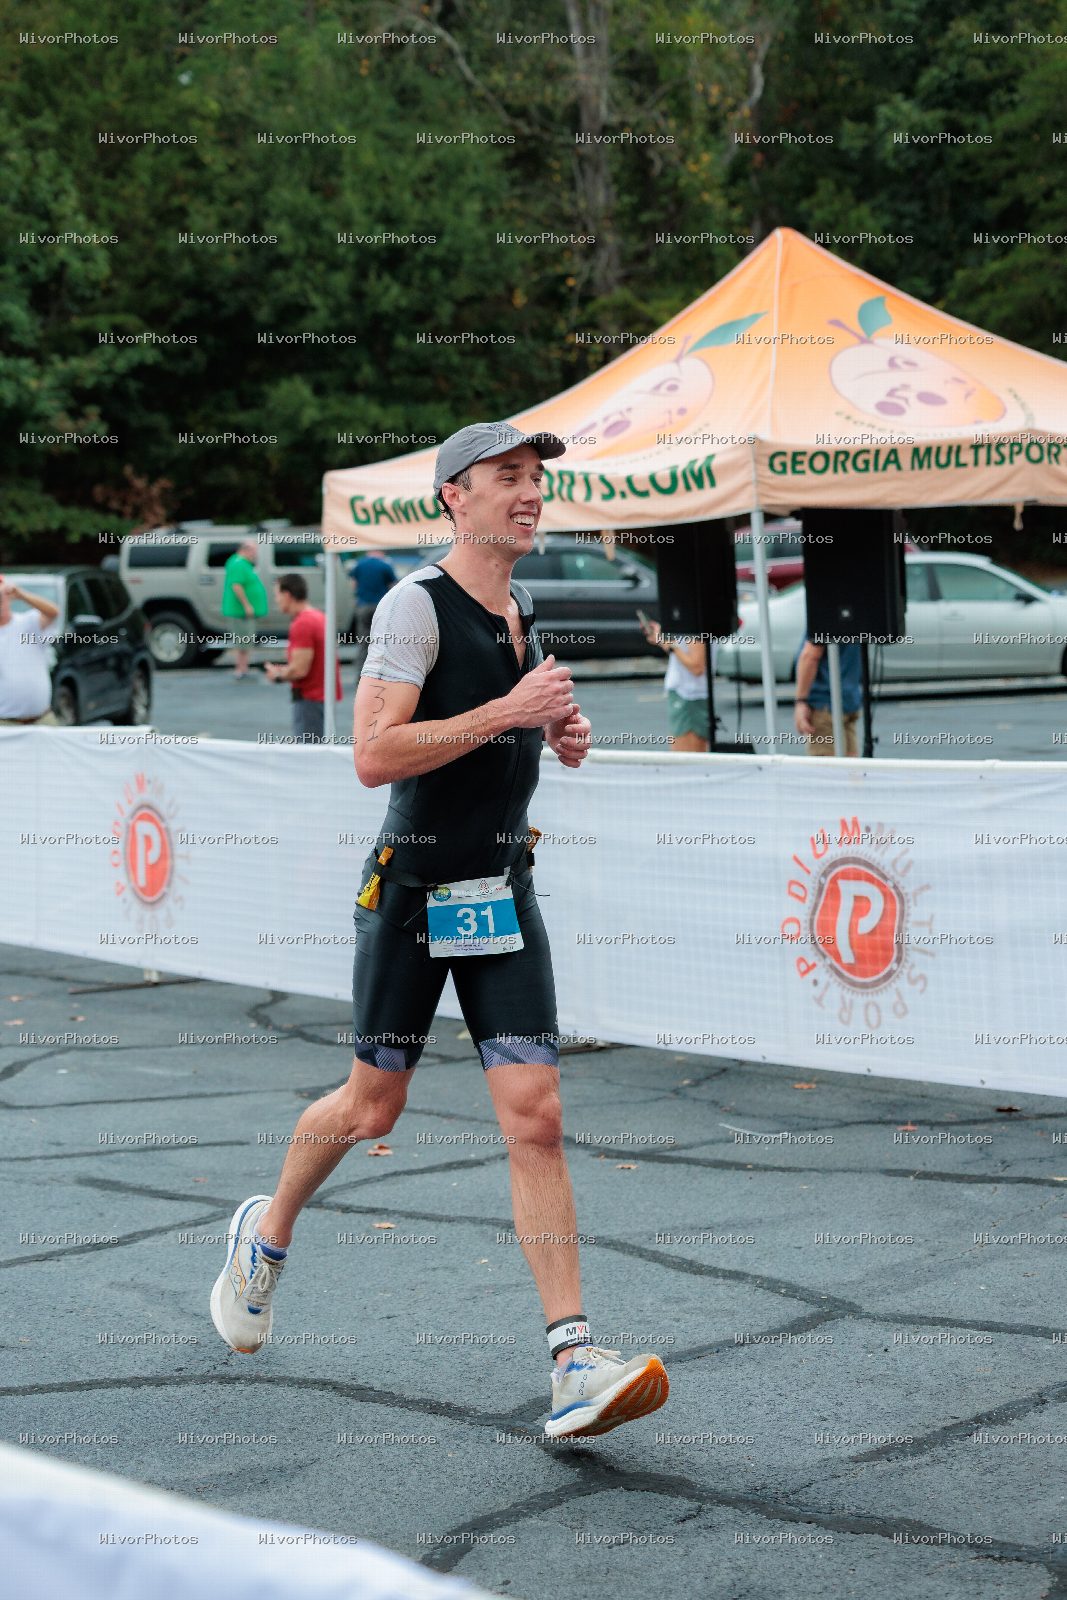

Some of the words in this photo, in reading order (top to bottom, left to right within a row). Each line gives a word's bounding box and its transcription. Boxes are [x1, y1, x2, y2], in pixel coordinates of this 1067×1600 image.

[768, 448, 903, 475] GEORGIA
[456, 905, 496, 936] 31
[780, 816, 861, 978] PODIUM
[836, 878, 885, 964] P
